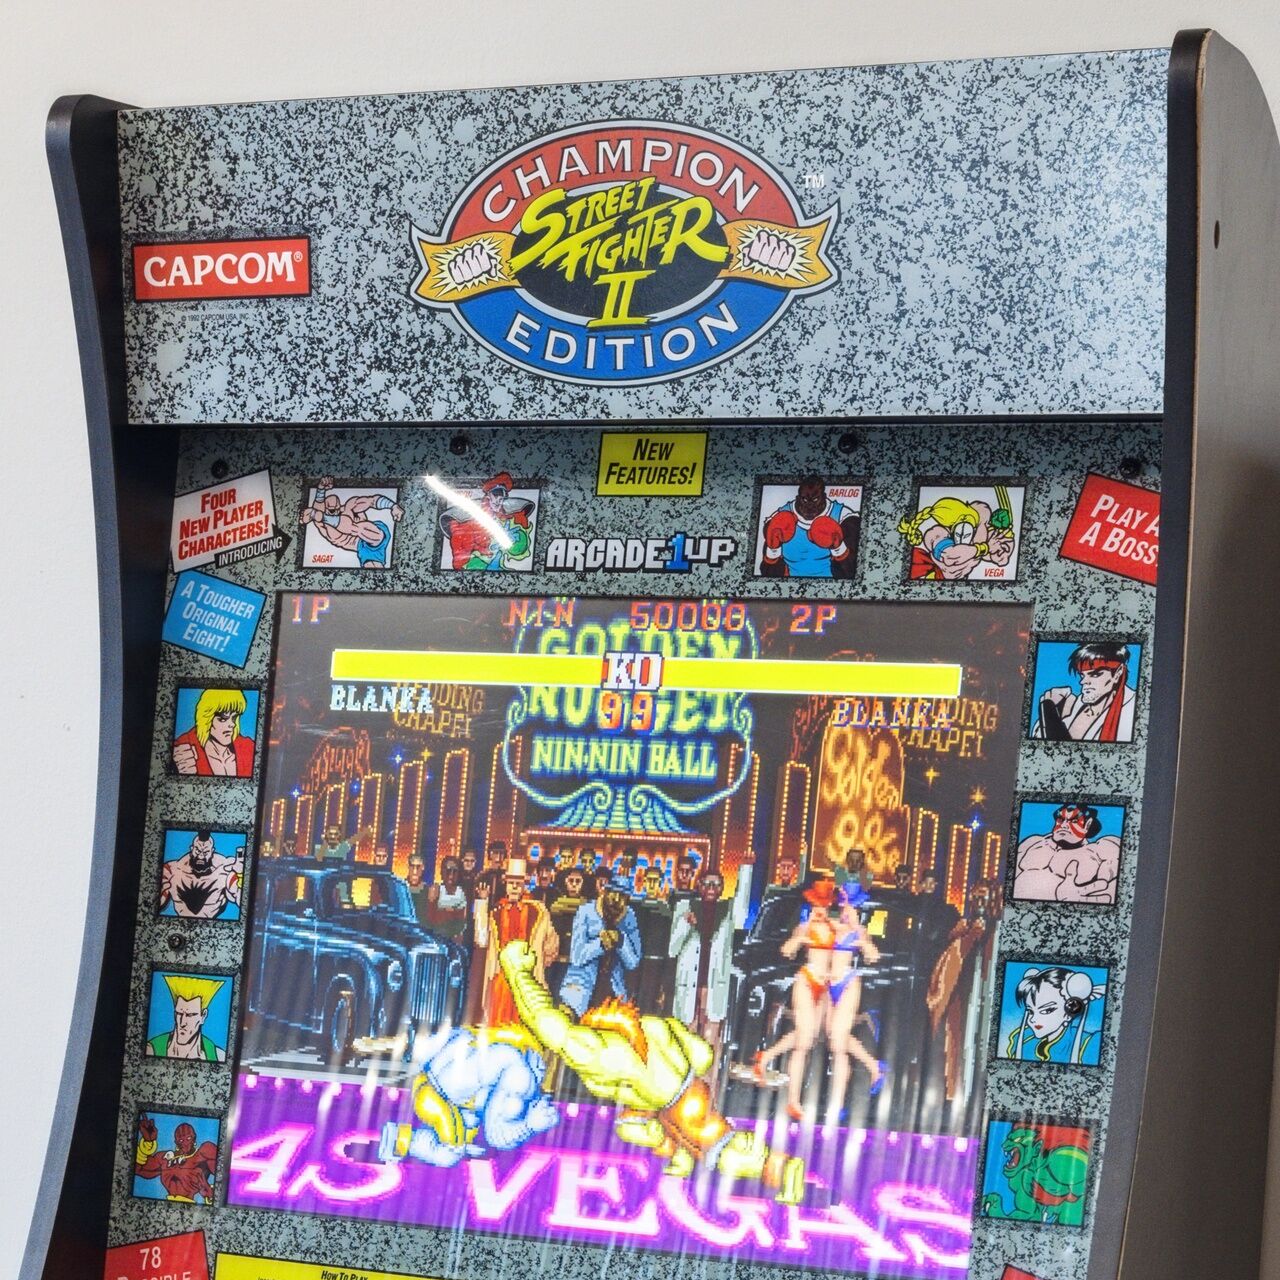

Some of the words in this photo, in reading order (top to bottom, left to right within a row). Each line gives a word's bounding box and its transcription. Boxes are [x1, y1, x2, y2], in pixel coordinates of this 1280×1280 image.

[482, 138, 760, 223] CHAMPION
[508, 177, 658, 275] STREET
[535, 196, 732, 282] FIGHTER
[586, 270, 656, 328] II
[201, 313, 225, 321] CAPCOM
[505, 302, 739, 371] EDITION
[633, 438, 675, 461] NEW
[605, 462, 697, 485] FEATURES!
[200, 488, 237, 513] FOUR
[828, 487, 860, 499] BARLOG
[179, 519, 212, 540] NEW
[213, 500, 264, 530] PLAYER
[1090, 494, 1149, 530] PLAY
[178, 515, 269, 560] CHARACTERS!
[219, 536, 283, 566] INTRODUCING
[547, 532, 736, 571] ARCADE1UP
[1078, 521, 1102, 547] A
[1101, 527, 1159, 567] BOSS
[311, 554, 334, 564] SAGAT
[984, 568, 1005, 578] VEGA
[181, 580, 195, 598] A
[199, 585, 256, 619] TOUGHER
[182, 602, 241, 637] ORIGINAL
[631, 601, 745, 632] 50000
[790, 604, 837, 634] 2P
[182, 622, 231, 652] EIGHT!
[602, 652, 664, 691] KO
[330, 684, 434, 713] BLANKA
[600, 692, 654, 730] 99
[832, 699, 952, 731] BLANKA
[466, 1146, 974, 1270] VEGAS
[140, 1246, 162, 1271] 78
[321, 1270, 338, 1280] HOW
